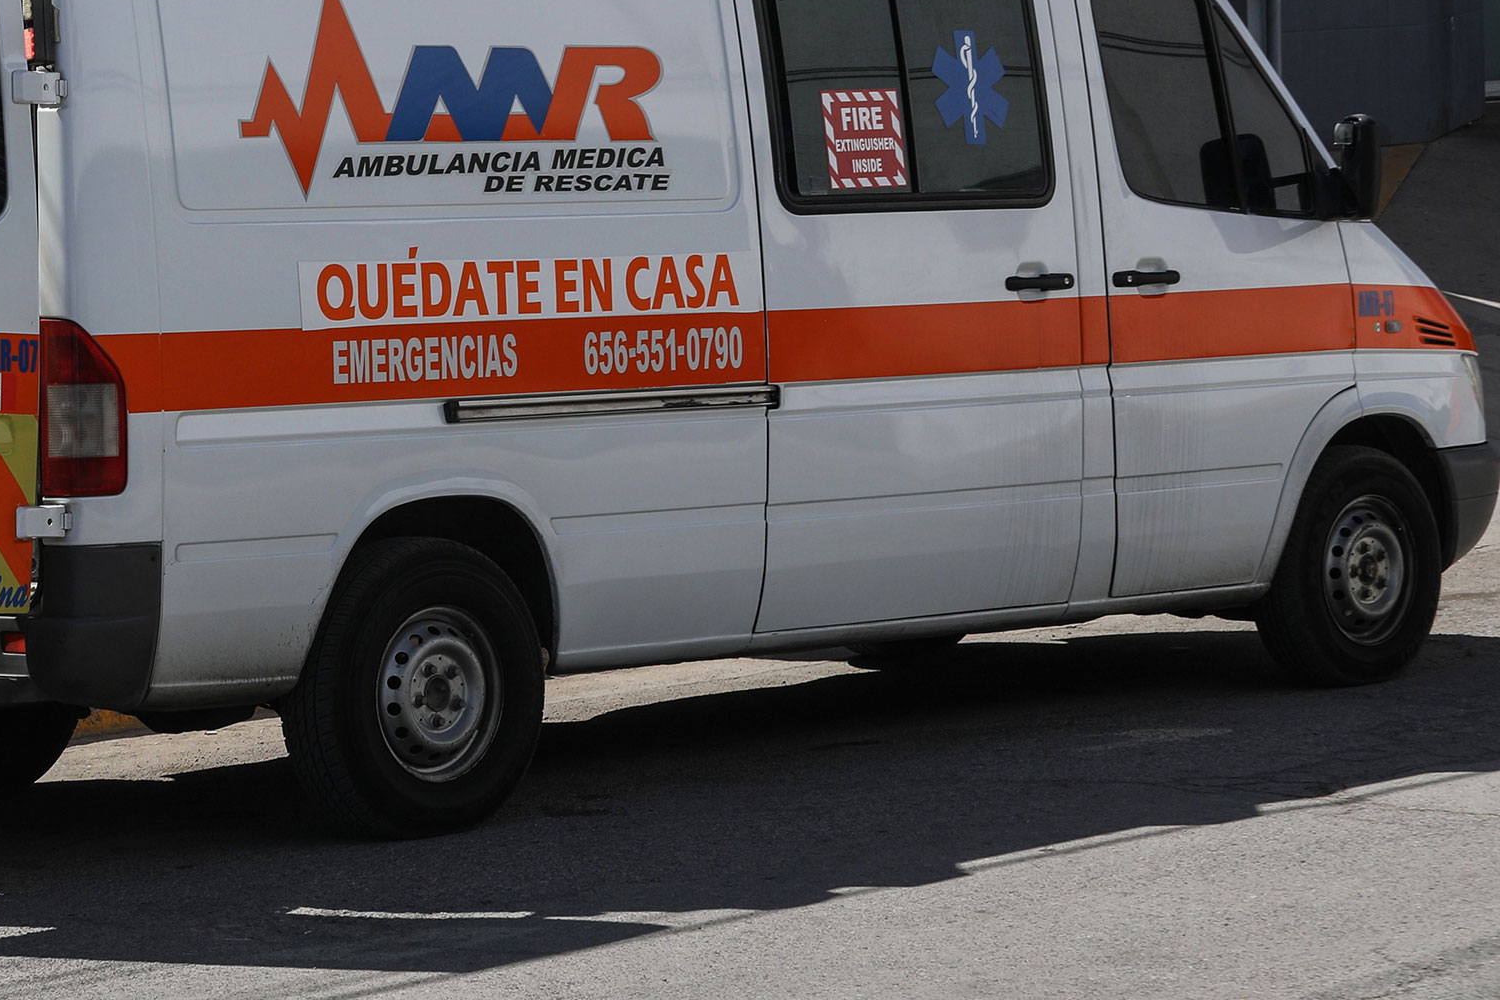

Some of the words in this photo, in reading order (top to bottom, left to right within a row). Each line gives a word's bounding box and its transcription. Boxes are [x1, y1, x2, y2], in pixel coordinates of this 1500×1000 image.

[840, 106, 884, 132] FIRE
[834, 137, 896, 153] EXTINGUISHER
[332, 150, 542, 179] AMBULANCIA
[550, 146, 666, 171] MEDICA
[851, 158, 884, 174] INSIDE
[483, 175, 525, 193] DE
[533, 173, 671, 193] RESCATE
[316, 246, 543, 322] QUÉDATE
[554, 257, 614, 314] EN
[625, 253, 741, 312] CASA
[332, 333, 519, 385] EMERGENCIAS
[583, 325, 743, 376] 656-551-0790
